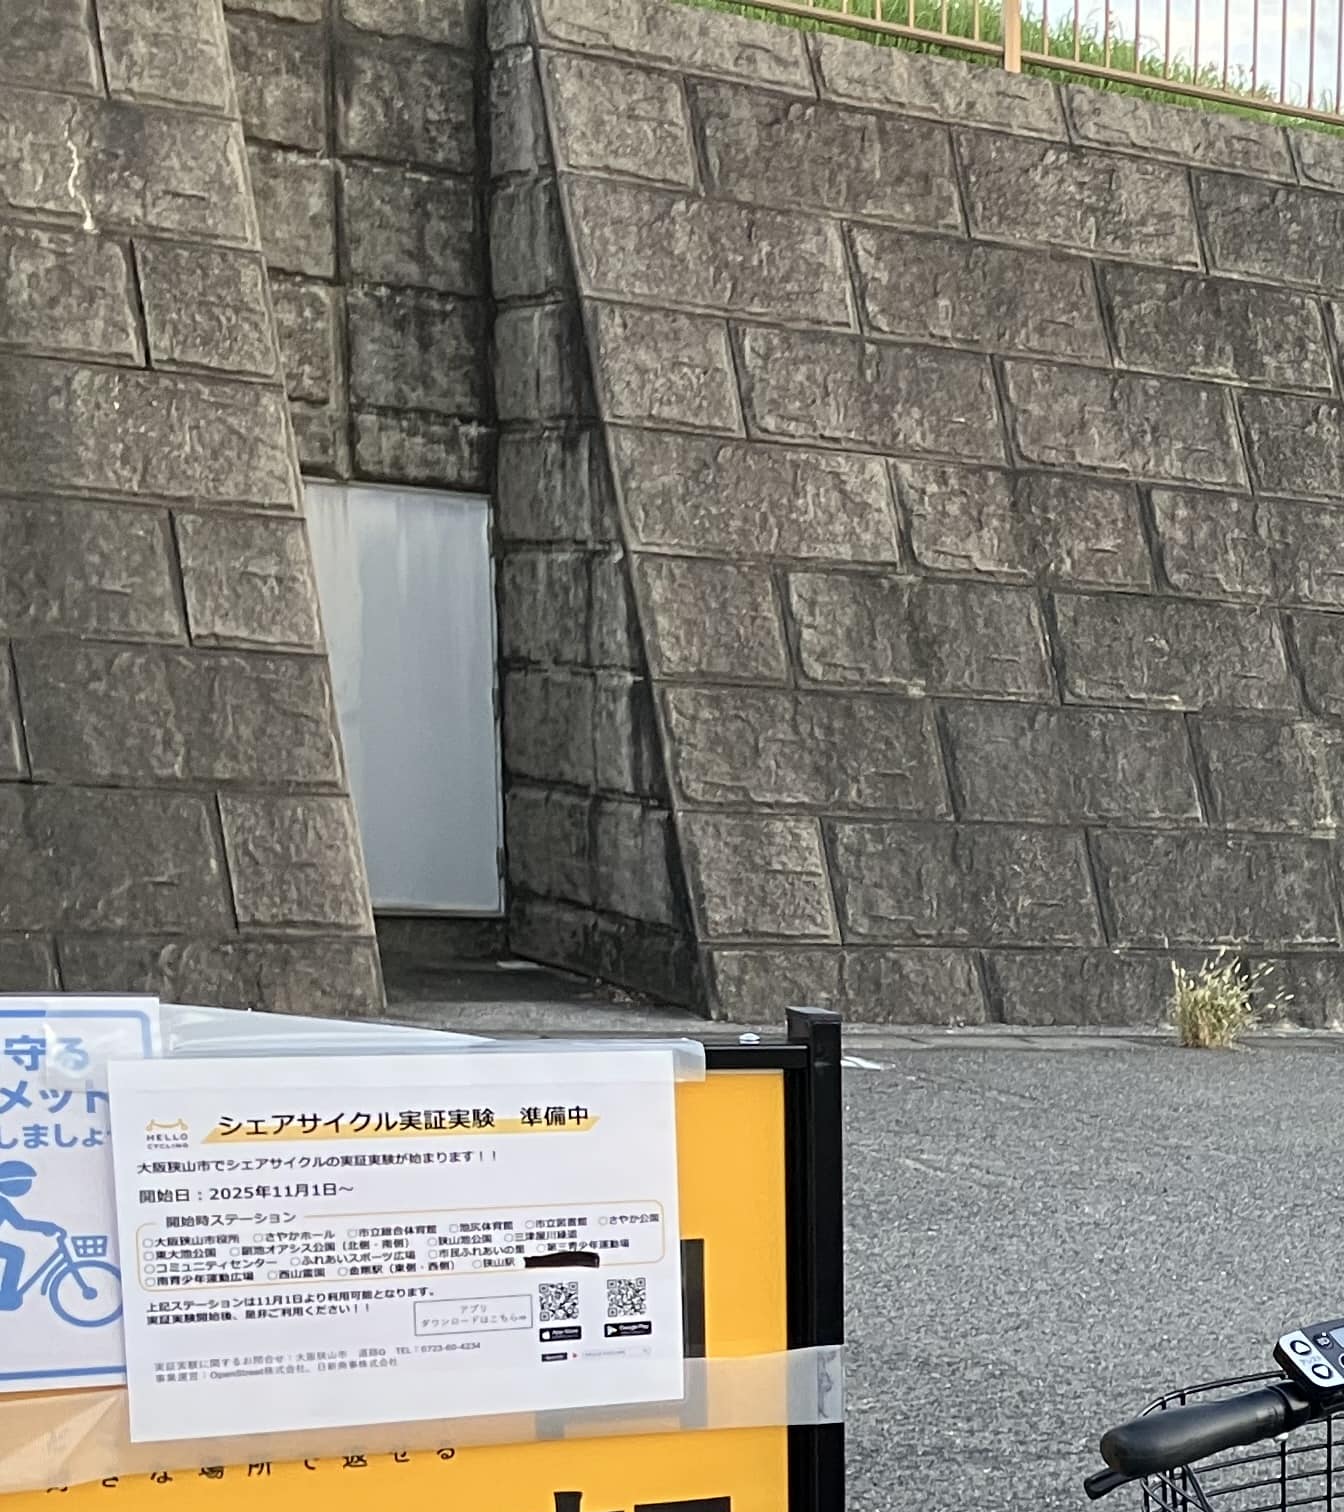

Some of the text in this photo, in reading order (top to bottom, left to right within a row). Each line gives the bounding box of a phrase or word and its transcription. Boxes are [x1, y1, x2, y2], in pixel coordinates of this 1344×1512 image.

[5, 1035, 90, 1071] 守る
[218, 1105, 589, 1136] シェアサイクル実証実験 準備中
[0, 1123, 111, 1149] しましょ
[147, 1132, 188, 1142] HELLO
[166, 1212, 297, 1228] 開始時ステーション
[156, 1258, 278, 1274] コミュニティセンター
